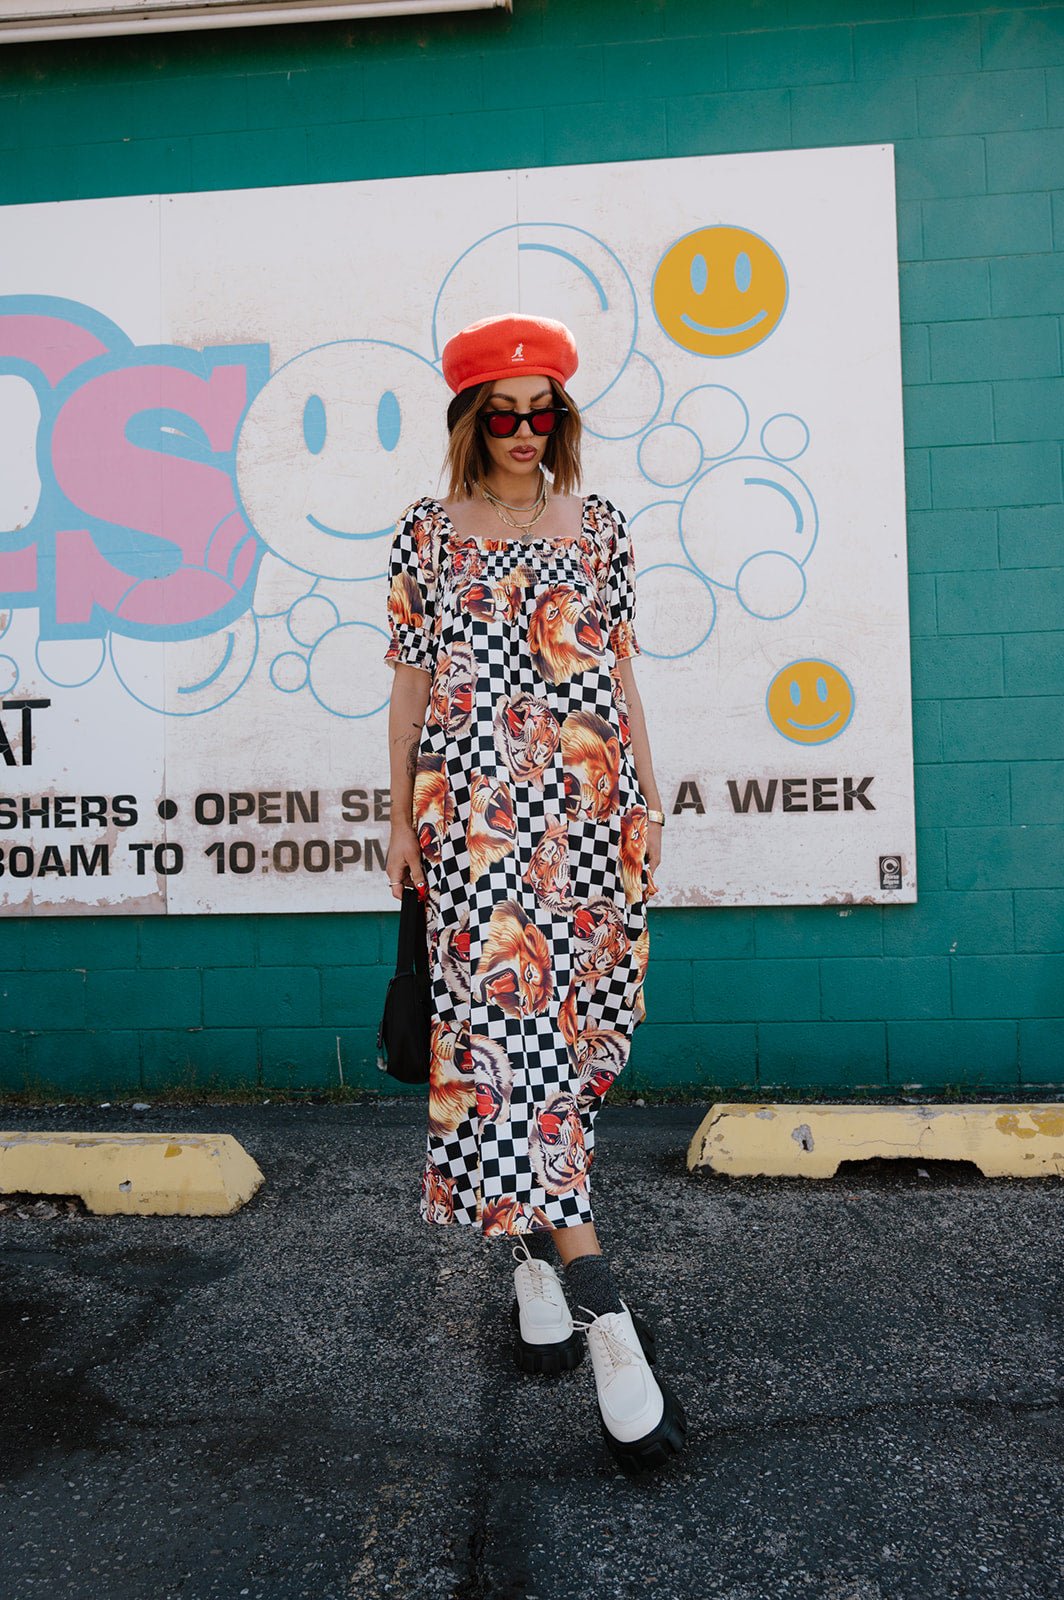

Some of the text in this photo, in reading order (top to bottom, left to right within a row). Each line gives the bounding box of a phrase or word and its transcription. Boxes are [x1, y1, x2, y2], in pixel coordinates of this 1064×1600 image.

[0, 699, 51, 766] T
[0, 795, 138, 830] SHERS
[195, 791, 319, 825] OPEN
[672, 781, 706, 814] A
[727, 777, 876, 814] WEEK
[0, 844, 109, 878] 0AM
[129, 843, 183, 875] TO
